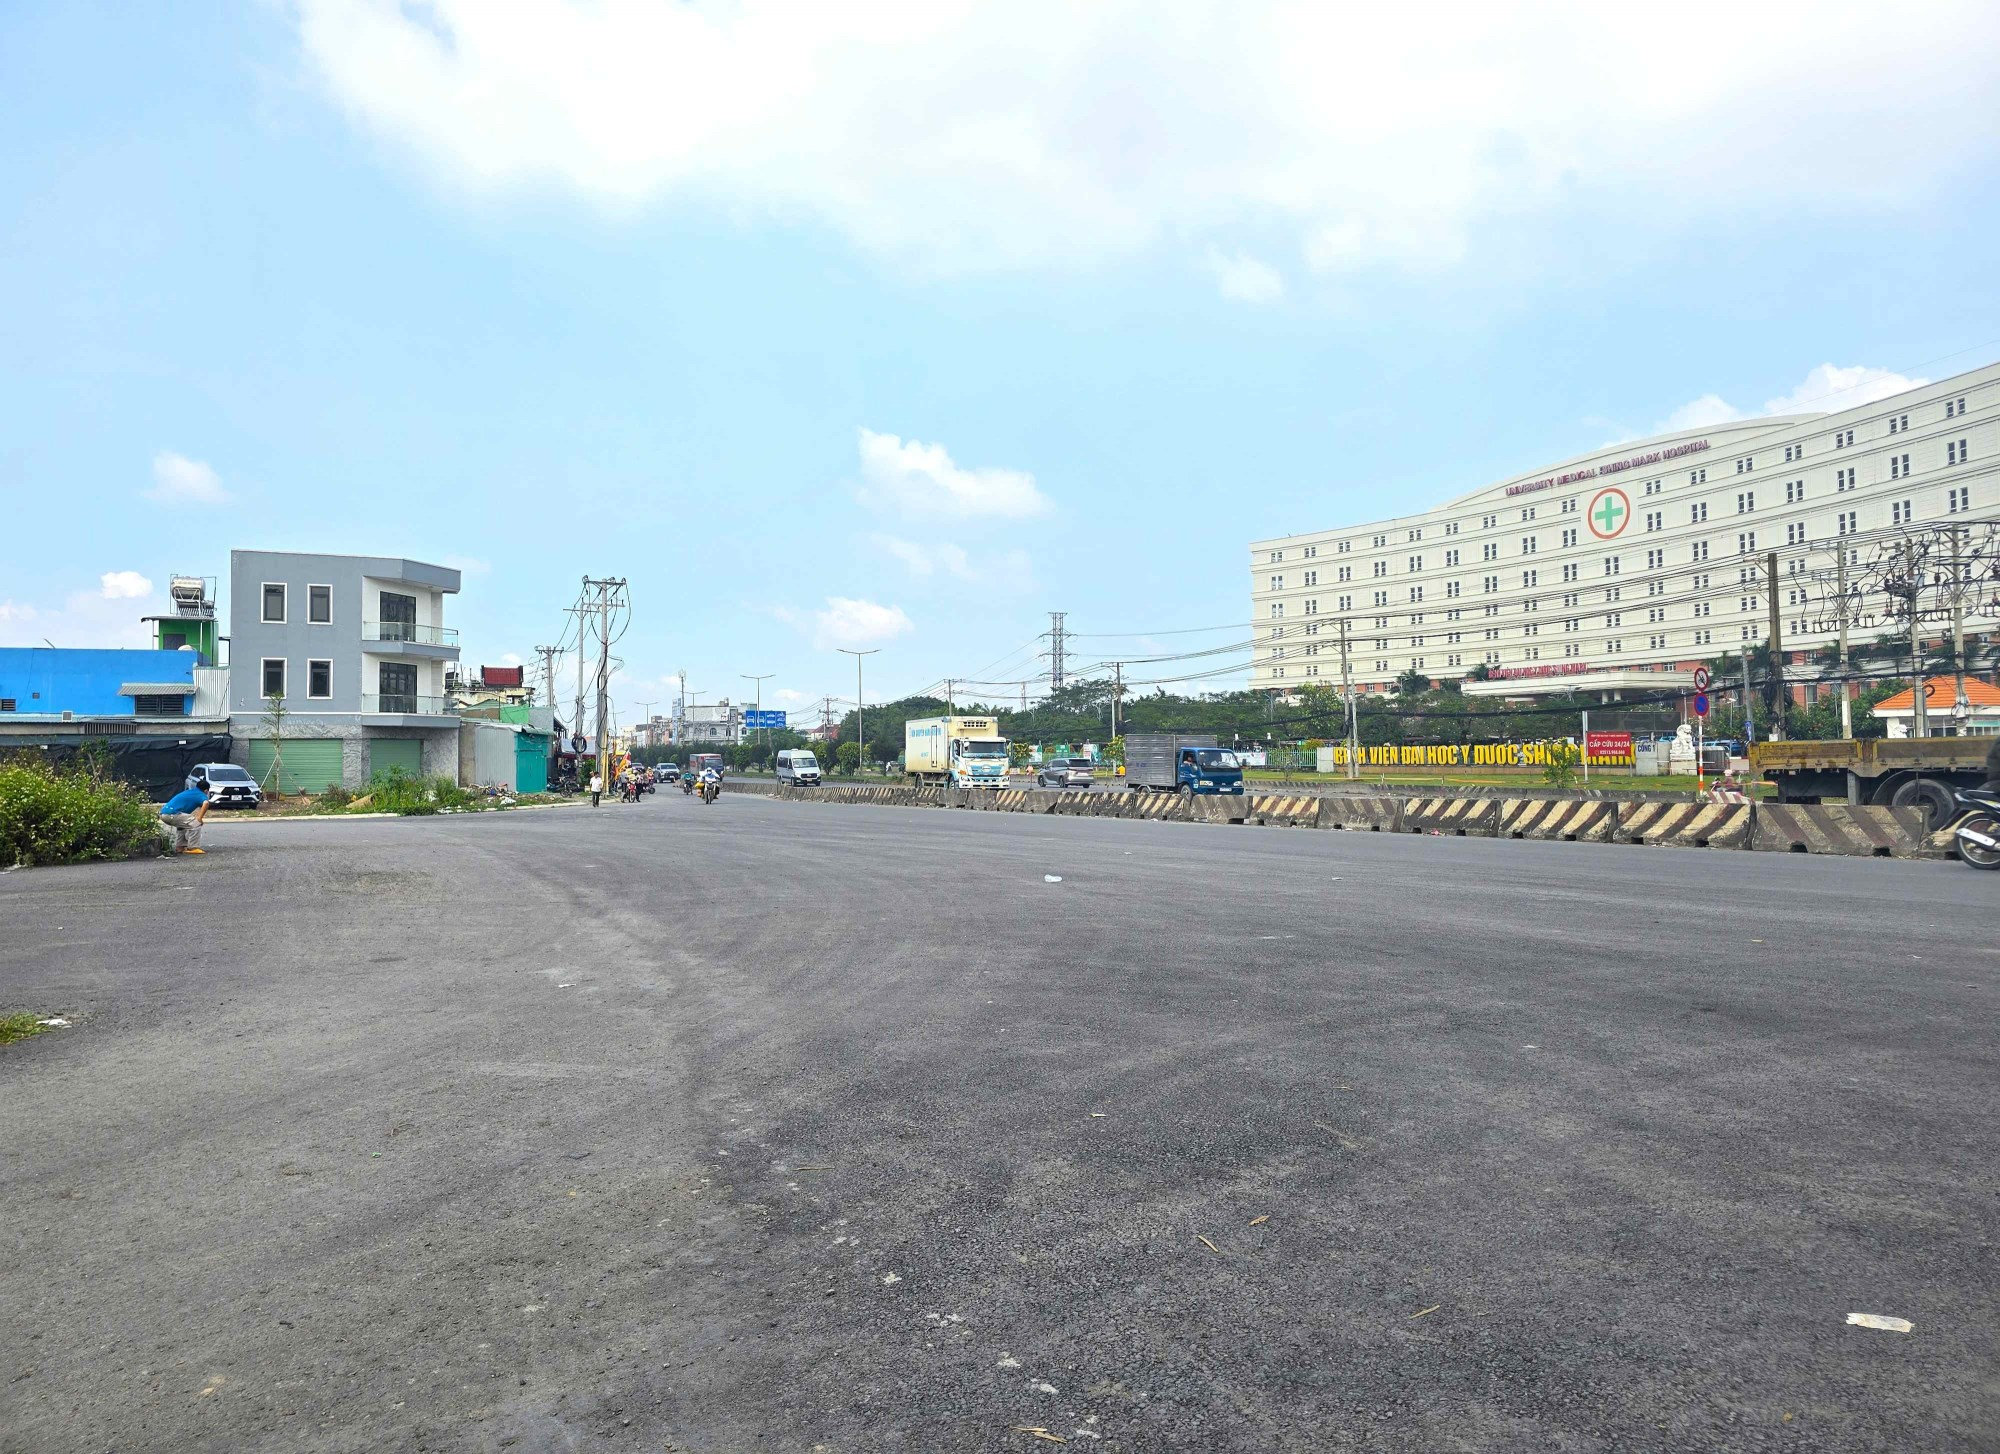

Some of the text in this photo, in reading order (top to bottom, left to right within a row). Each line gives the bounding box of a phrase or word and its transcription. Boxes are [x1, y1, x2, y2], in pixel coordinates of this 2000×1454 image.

[1505, 439, 1711, 497] UNIVERSITY MEDICAL SHING MARK HOSPITAL
[1333, 745, 1366, 766] BH
[1460, 744, 1470, 765] Y
